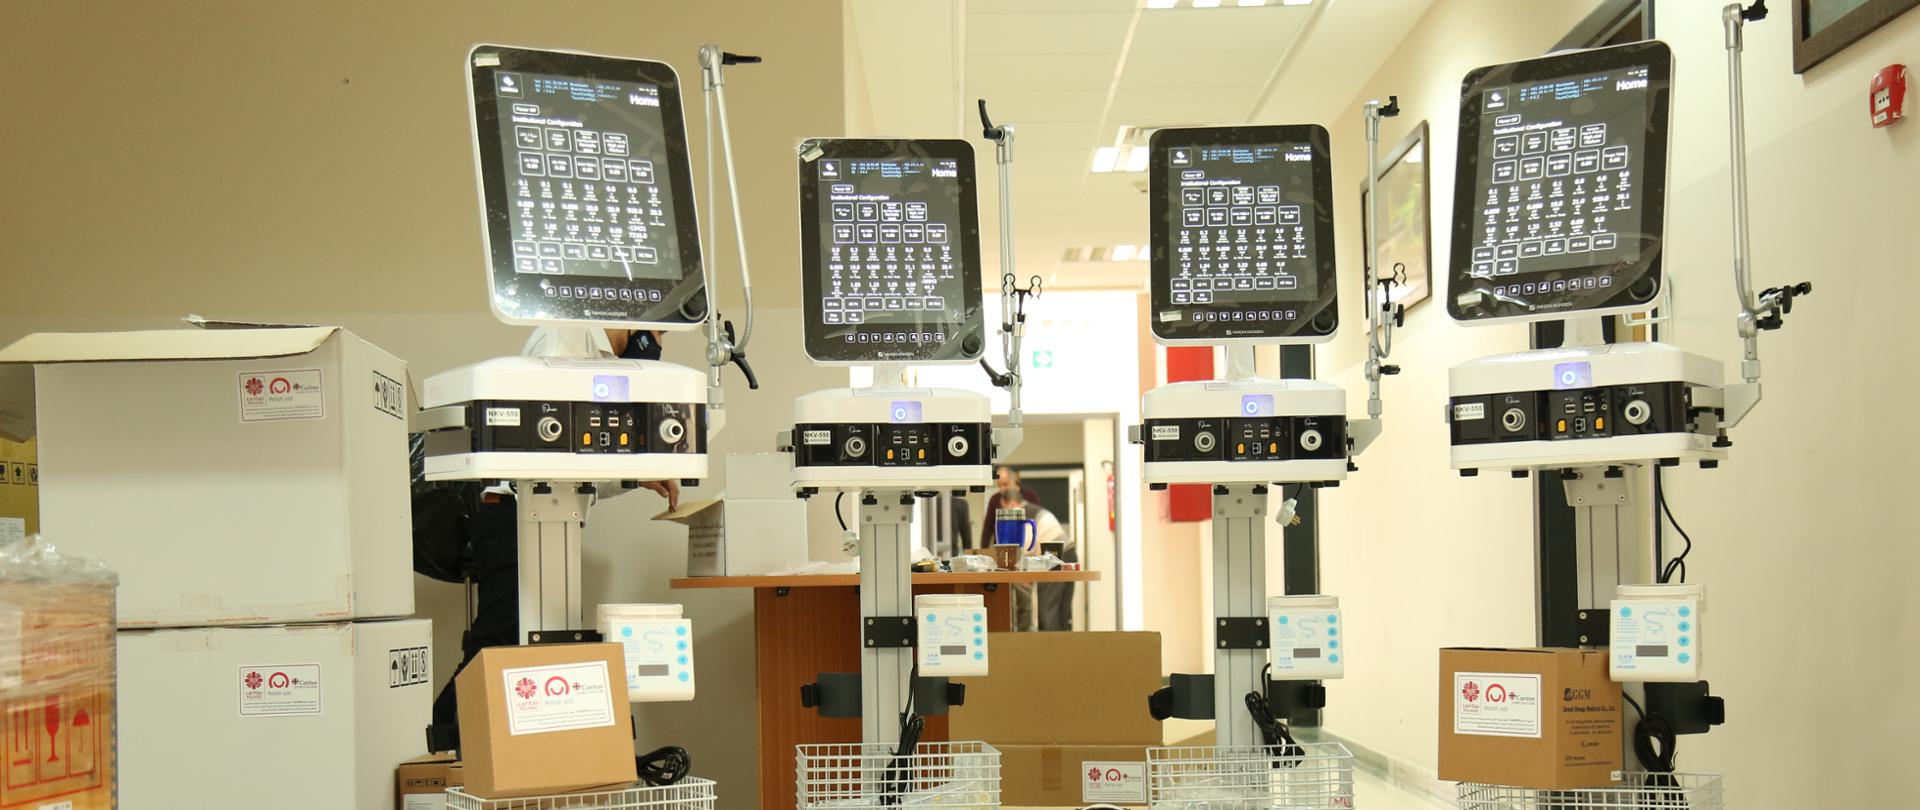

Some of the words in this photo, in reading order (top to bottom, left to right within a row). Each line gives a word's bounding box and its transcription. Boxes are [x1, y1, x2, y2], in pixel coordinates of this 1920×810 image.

[1616, 78, 1647, 90] Home
[630, 95, 659, 106] Home
[546, 118, 582, 127] Configuration
[1493, 125, 1524, 134] Institutional
[1526, 120, 1561, 130] Configuration
[1285, 152, 1310, 160] Home
[931, 168, 956, 176] Home
[1573, 689, 1591, 700] GGM
